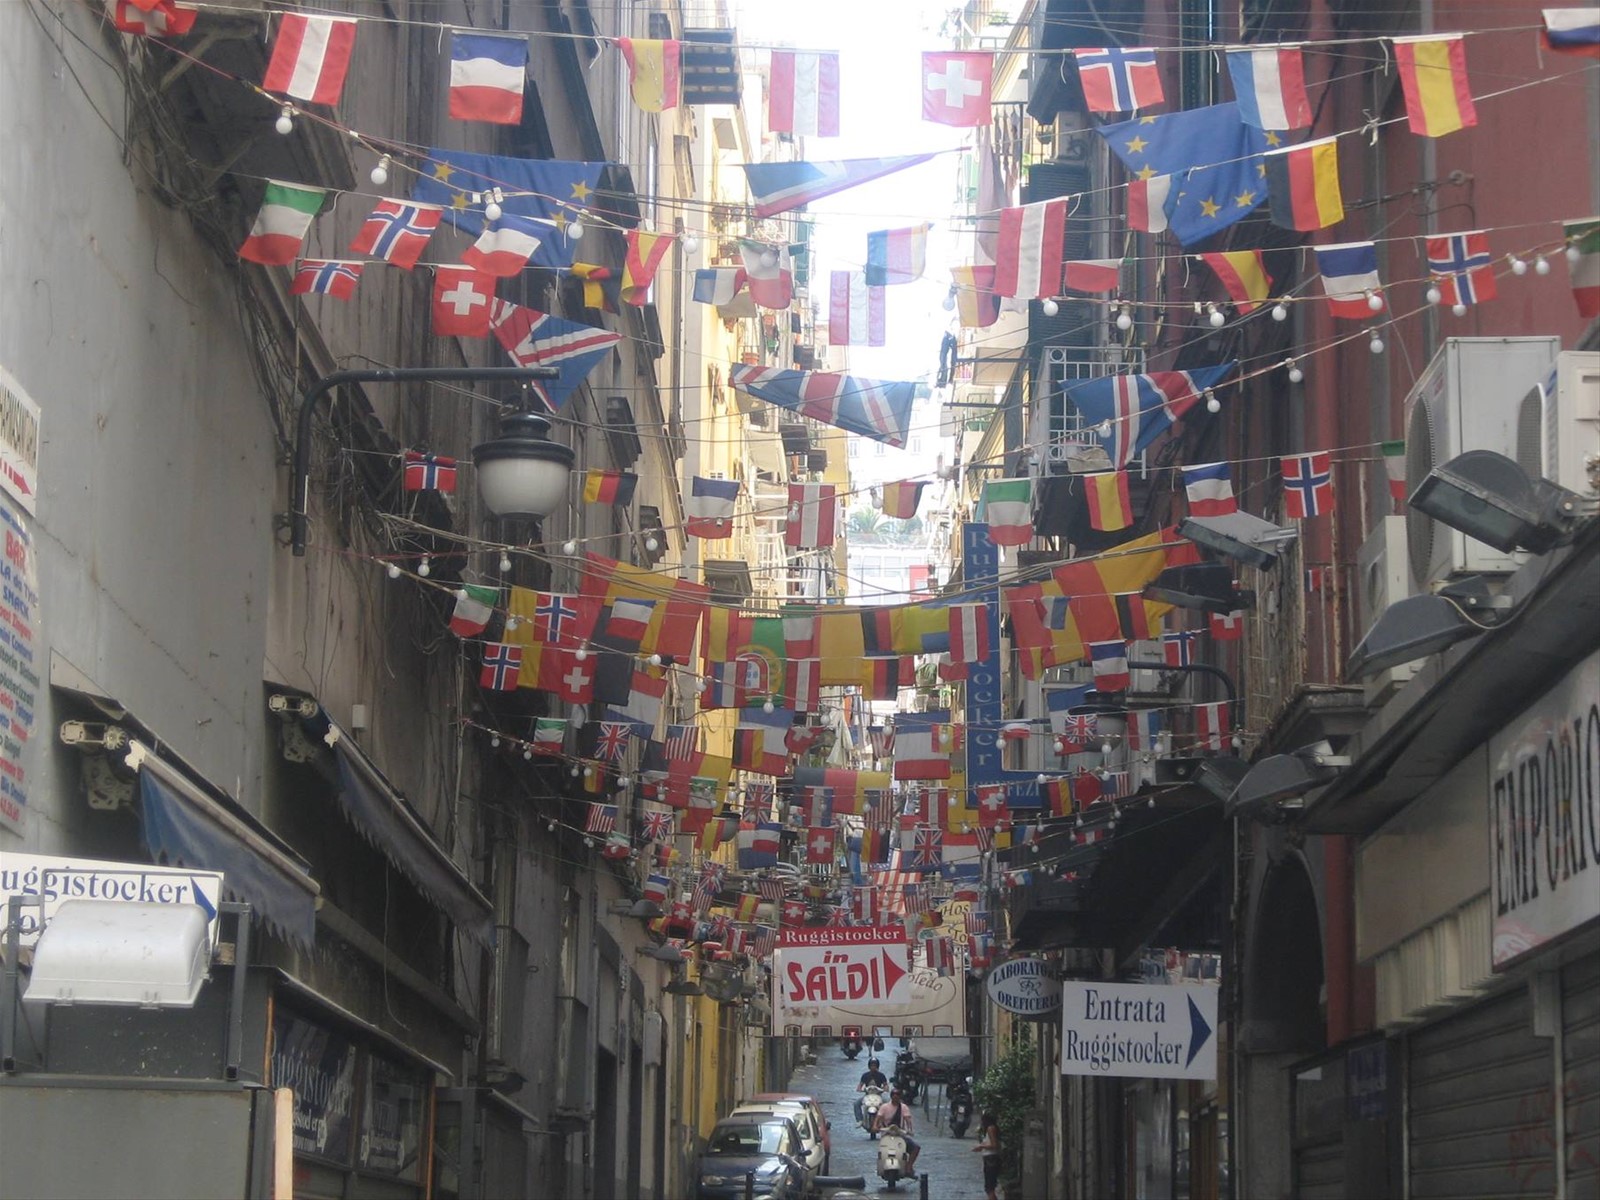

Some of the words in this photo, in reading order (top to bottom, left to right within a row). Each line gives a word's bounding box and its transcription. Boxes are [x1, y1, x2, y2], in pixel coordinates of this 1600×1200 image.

[5, 529, 26, 574] BAR
[1494, 703, 1600, 917] EMPORIO
[1, 866, 188, 904] uggistocker
[785, 928, 901, 945] Ruggistocker
[787, 957, 880, 1002] SALDI
[907, 972, 943, 992] oledo
[998, 990, 1060, 1011] OREFICERIA
[1084, 989, 1166, 1023] Entrata
[1066, 1029, 1182, 1071] Ruggistocker
